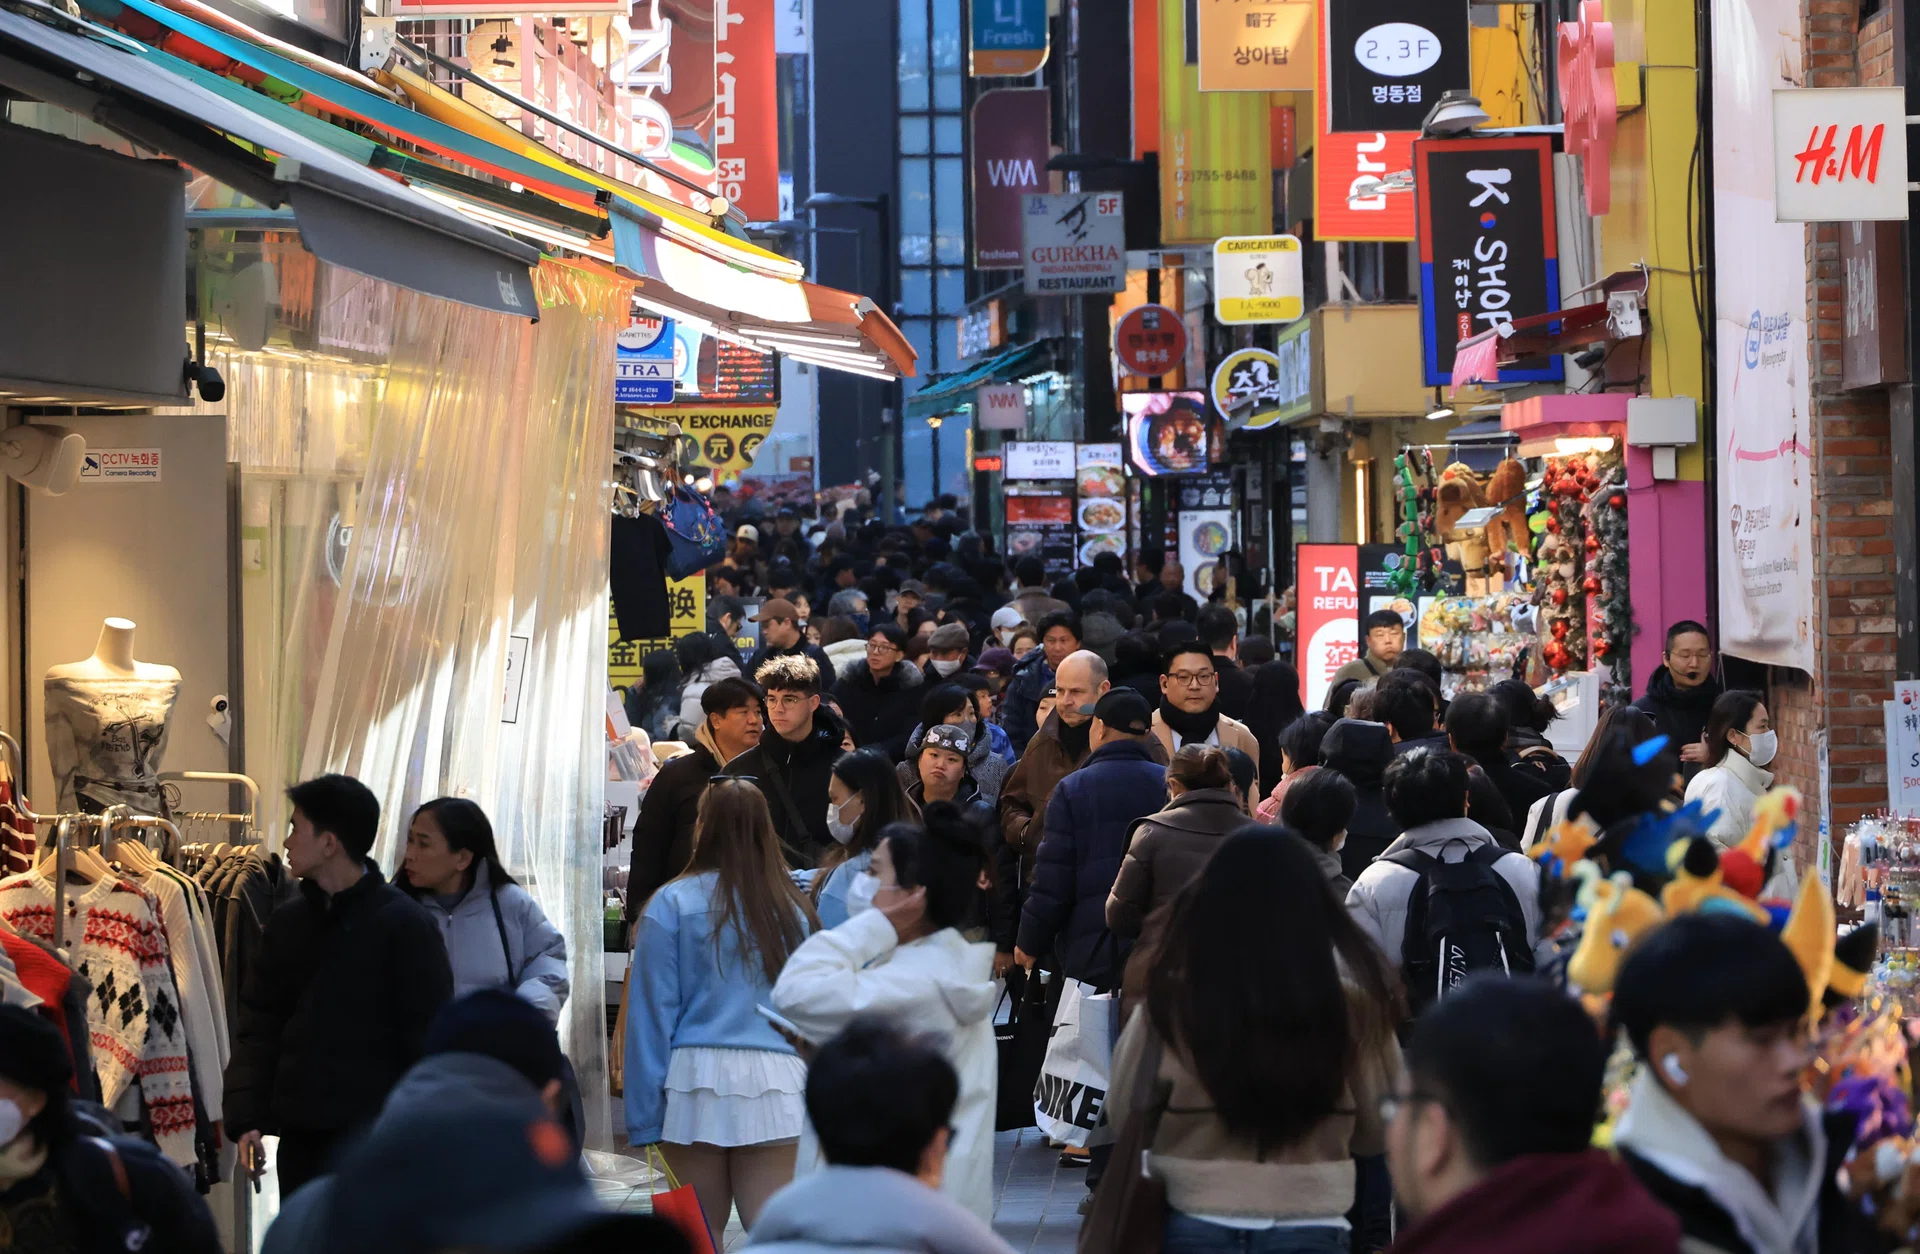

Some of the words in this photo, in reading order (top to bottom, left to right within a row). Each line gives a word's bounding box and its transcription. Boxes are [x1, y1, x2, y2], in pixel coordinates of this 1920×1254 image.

[984, 29, 1035, 45] Fresh
[1234, 46, 1289, 66] 상아탑
[1366, 39, 1430, 61] 2,3F
[1372, 84, 1422, 103] 명동점
[1794, 123, 1885, 186] H&M
[987, 159, 1038, 187] WM
[1466, 168, 1512, 207] K
[1098, 198, 1119, 215] 5F
[1031, 245, 1119, 263] GURKHA
[1227, 240, 1289, 251] CARICATURE
[980, 249, 1019, 260] fashion
[1038, 276, 1116, 290] RESTAURANT
[1452, 258, 1472, 309] 케이샵
[1474, 236, 1515, 336] SHOP
[988, 393, 1018, 408] WM
[690, 414, 773, 428] EXCHANGE
[102, 453, 129, 465] CCTV
[131, 452, 160, 466] 녹화중
[128, 469, 157, 478] Recording
[1314, 596, 1358, 609] REFU
[1033, 1072, 1107, 1131] NIKE
